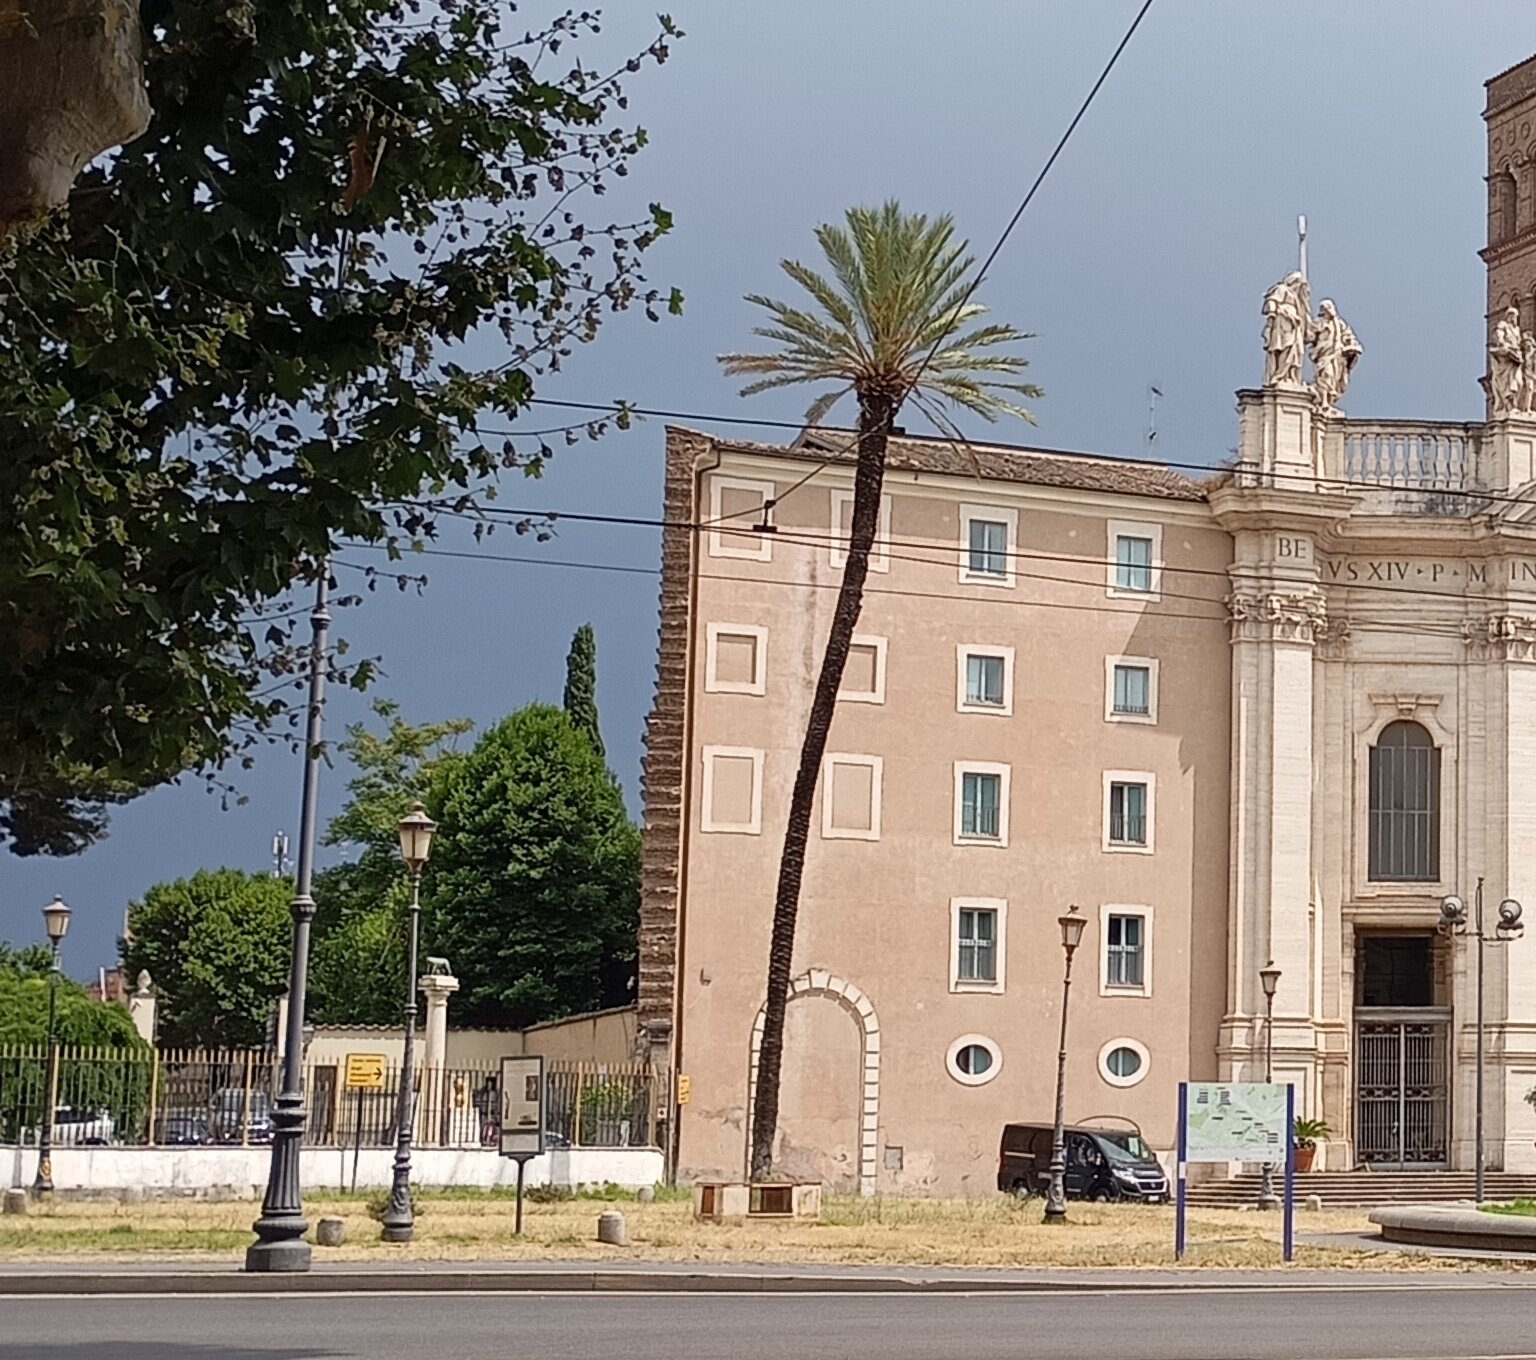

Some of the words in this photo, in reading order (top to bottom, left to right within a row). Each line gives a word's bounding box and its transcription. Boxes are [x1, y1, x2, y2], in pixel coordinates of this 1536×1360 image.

[1278, 537, 1307, 559] BE
[1367, 562, 1409, 581] XIV
[1432, 563, 1445, 582] P
[1469, 564, 1488, 582] M
